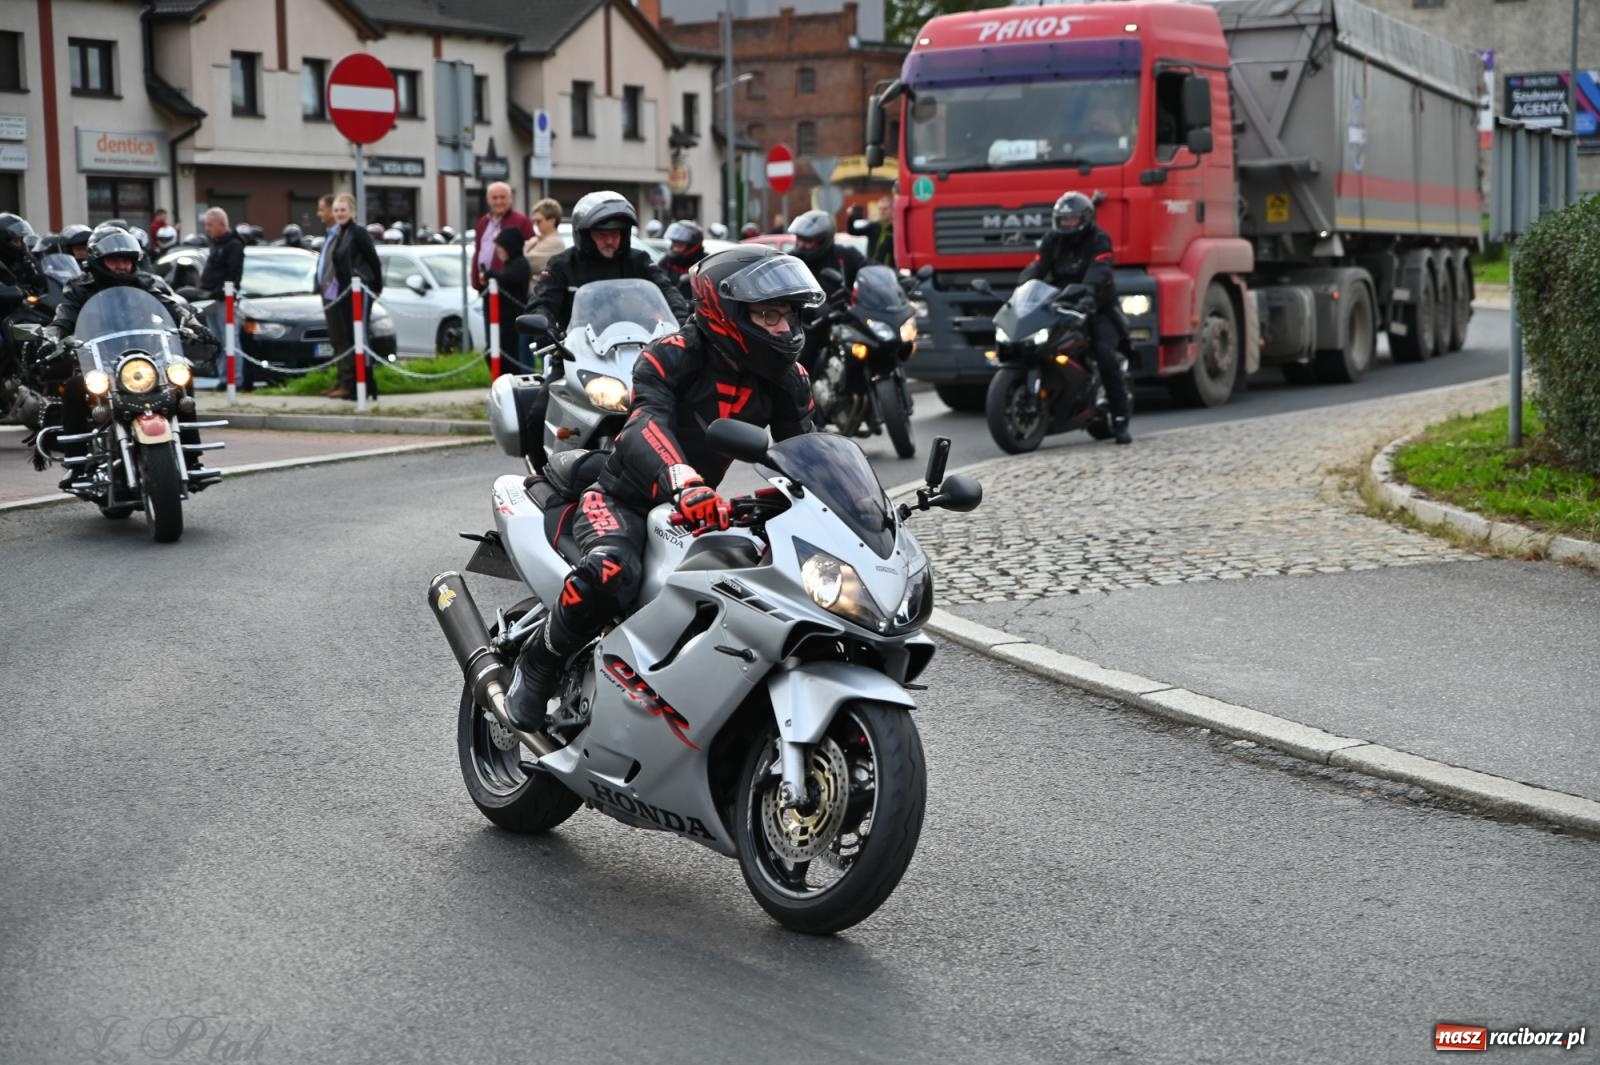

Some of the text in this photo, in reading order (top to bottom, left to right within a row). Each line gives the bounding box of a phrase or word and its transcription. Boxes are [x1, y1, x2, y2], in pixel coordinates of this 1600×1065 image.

[976, 15, 1080, 42] PAKOS
[96, 132, 156, 156] dentica
[982, 214, 1042, 229] MAN
[654, 526, 685, 549] HONDA
[588, 779, 718, 841] HONDA
